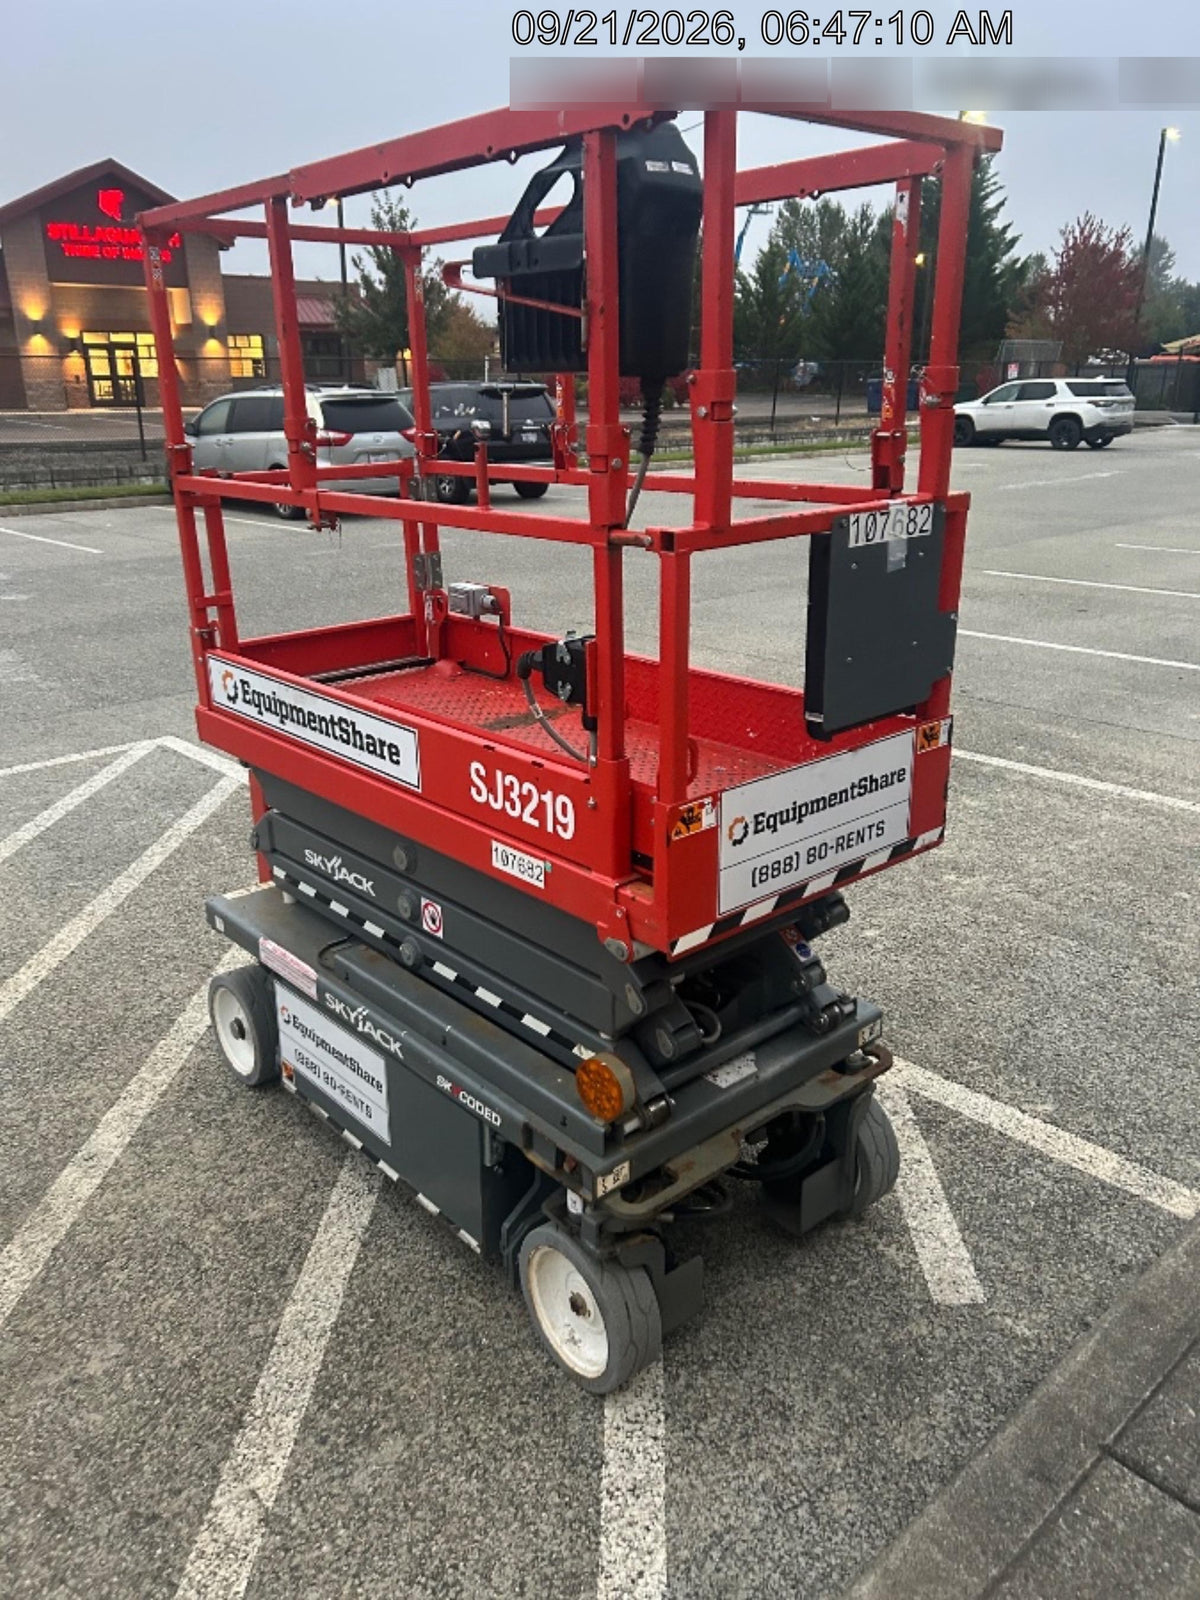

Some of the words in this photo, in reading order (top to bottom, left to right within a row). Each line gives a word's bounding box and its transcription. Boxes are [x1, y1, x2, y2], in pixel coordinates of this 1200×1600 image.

[851, 505, 931, 545] 107682
[239, 678, 401, 766] EquipmentShare
[469, 760, 576, 841] SJ3219
[752, 767, 907, 835] EquipmentShare
[304, 848, 376, 897] SKYJACK
[493, 847, 544, 883] 107682
[751, 855, 800, 888] (888)
[806, 819, 886, 866] 80-RENTS
[291, 1013, 384, 1094] EquipmentShare
[324, 991, 404, 1059] SKYJACK
